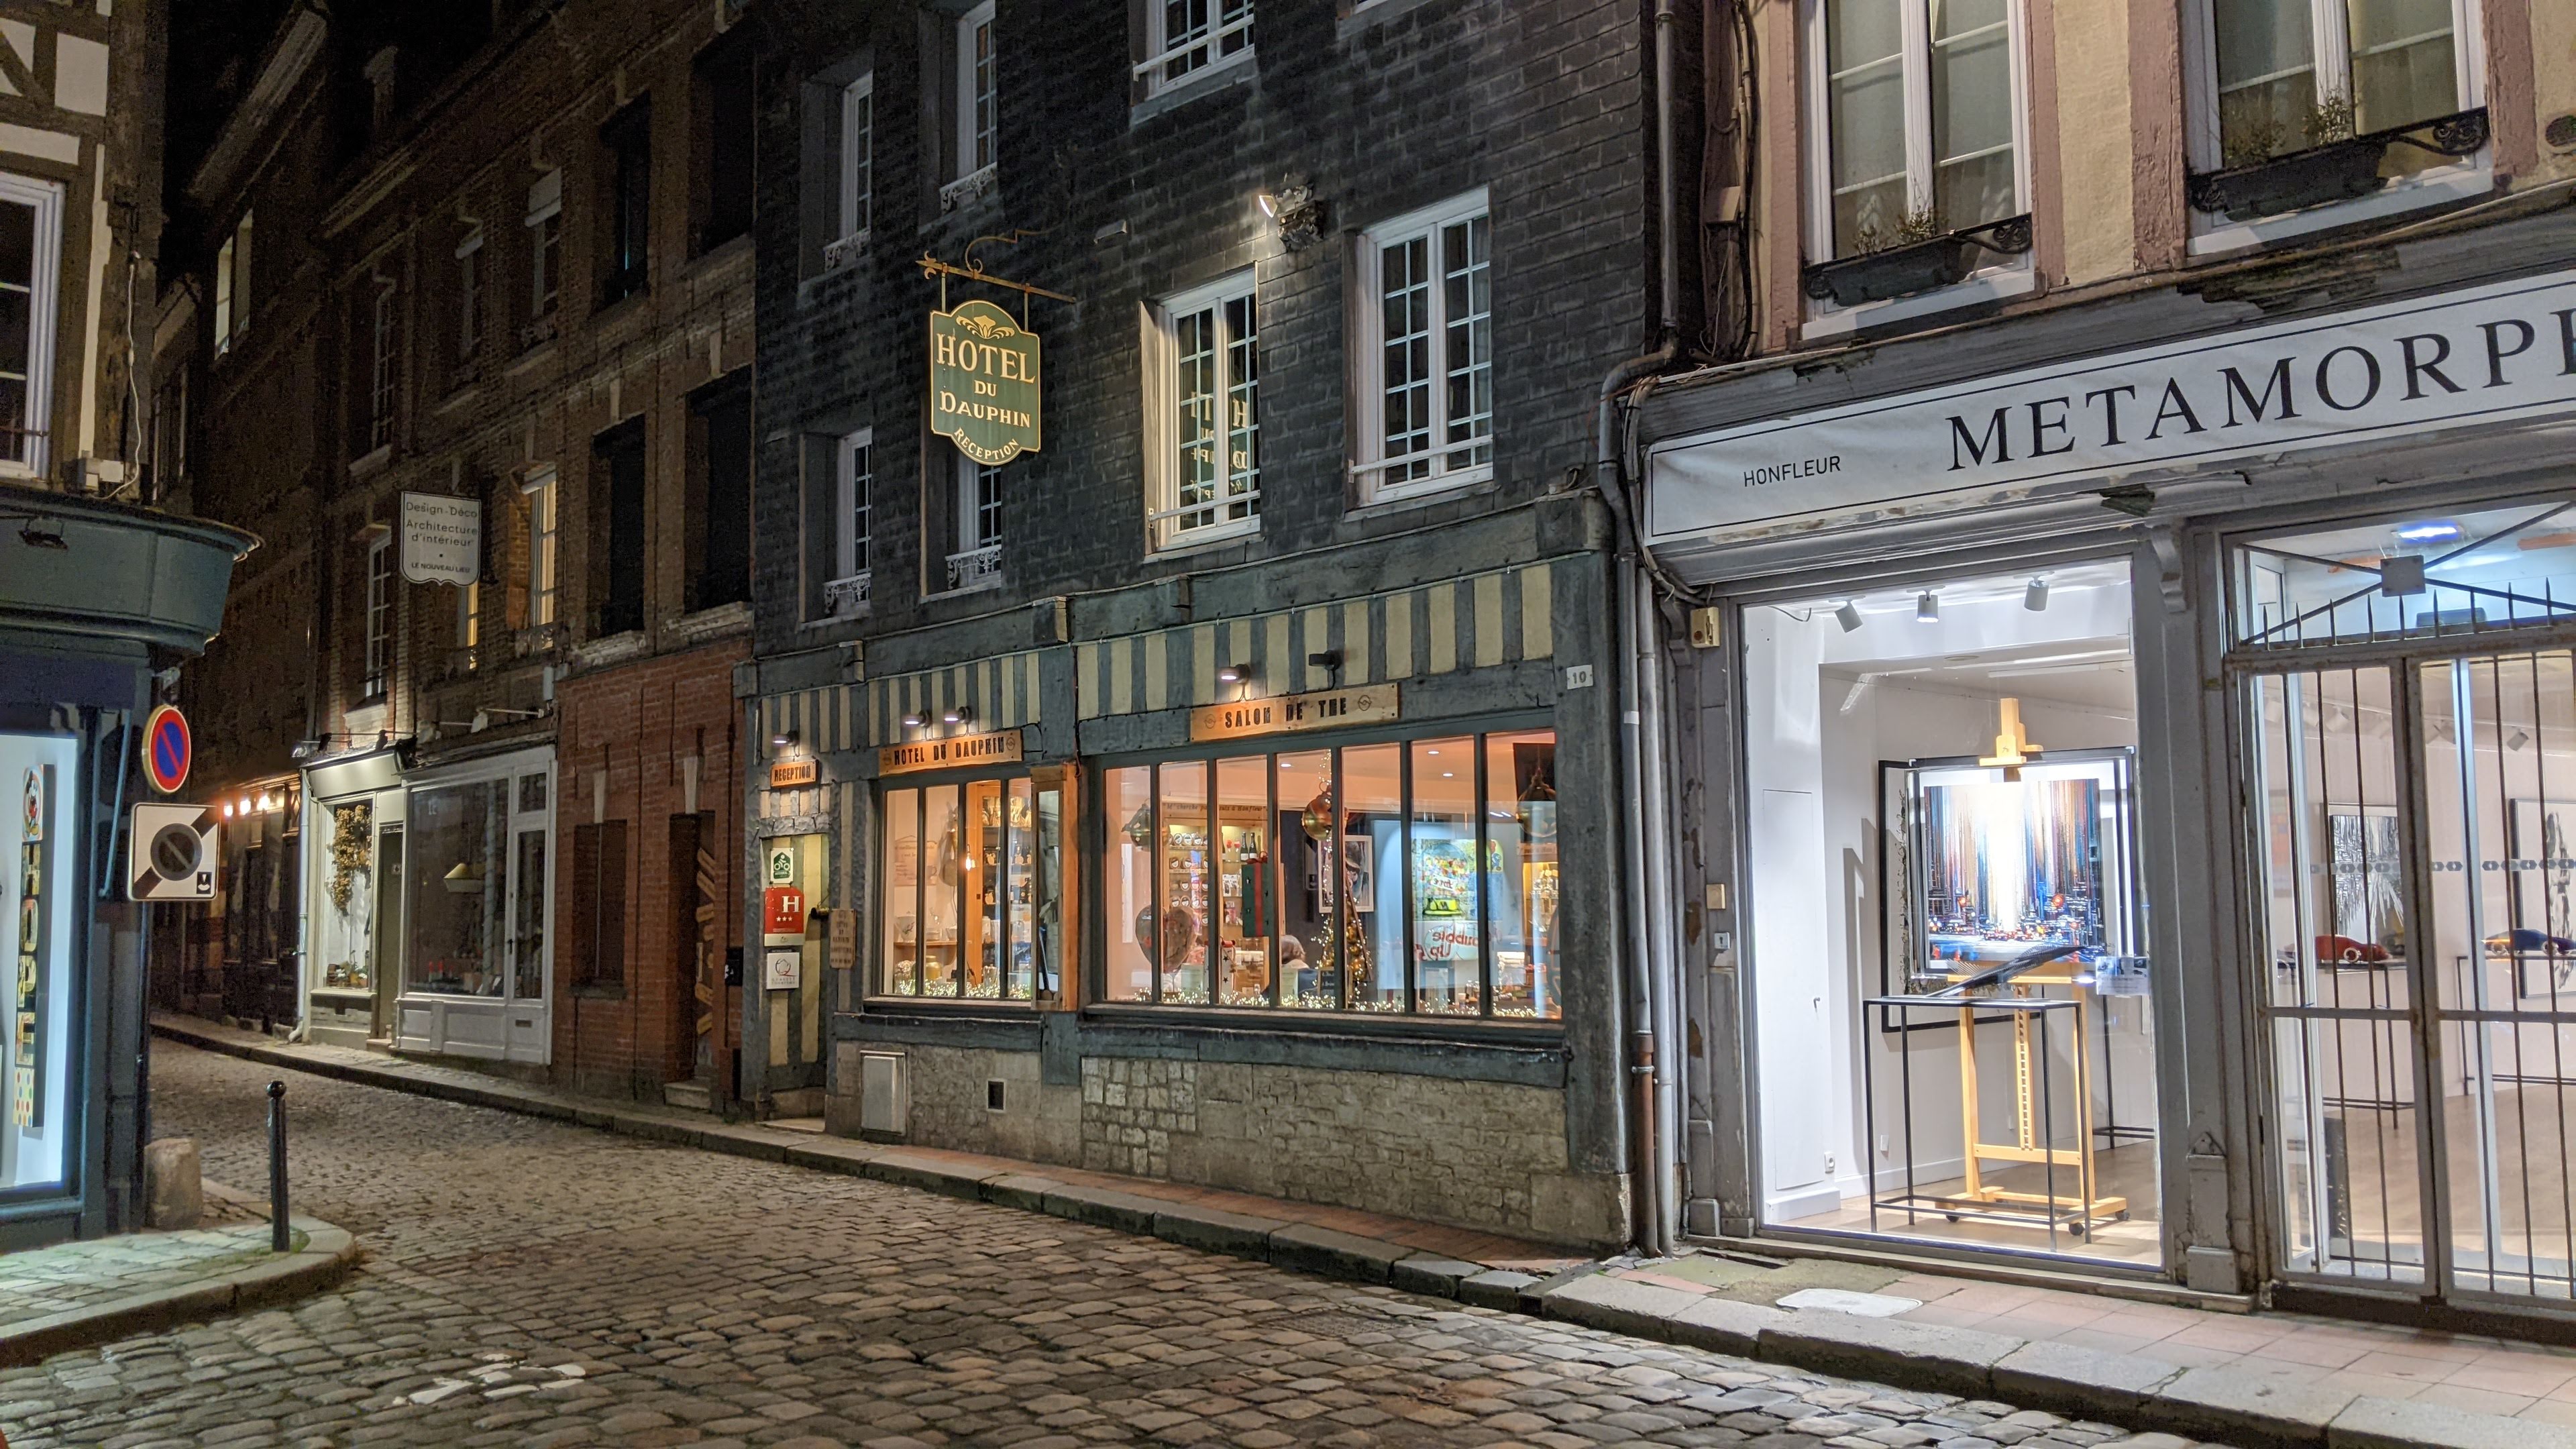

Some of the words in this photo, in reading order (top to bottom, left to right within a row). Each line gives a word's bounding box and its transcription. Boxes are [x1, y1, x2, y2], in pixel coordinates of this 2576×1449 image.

[936, 333, 1036, 384] HOTEL
[974, 380, 998, 396] DU
[939, 390, 1031, 428] DAUPHIN
[954, 427, 1020, 460] RECEPTION
[1743, 455, 1841, 487] HONFLEUR
[405, 502, 443, 515] Design
[449, 506, 478, 518] Déco
[406, 519, 478, 535] Architecture
[411, 533, 472, 547] d'intérieur
[421, 563, 455, 572] NOUVEAU
[1572, 671, 1587, 684] 10
[1225, 707, 1271, 728] SALON
[1285, 702, 1303, 722] DE
[1318, 697, 1346, 718] THE
[894, 747, 925, 765] HOTEL
[933, 744, 947, 761] DU
[955, 737, 1005, 758] DAUPHIN
[774, 765, 811, 782] RECEPTION
[782, 896, 800, 913] H
[15, 843, 41, 1066] HOPE
